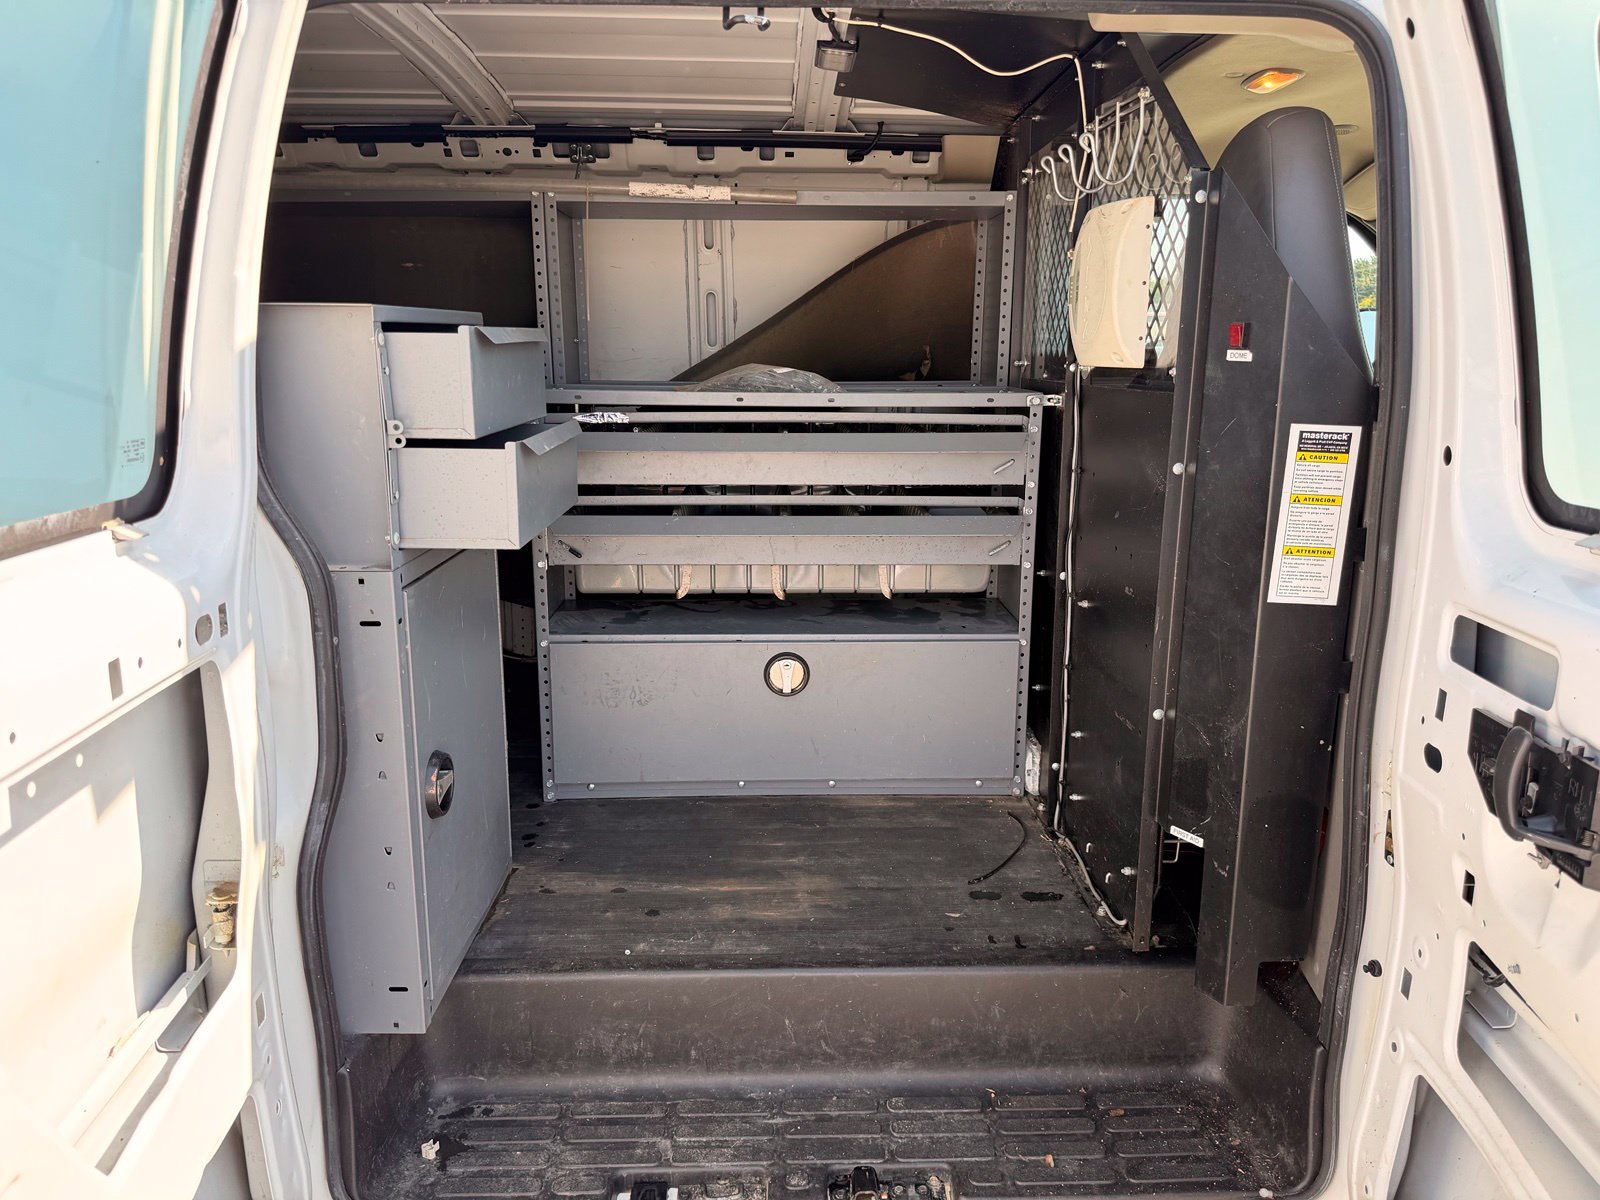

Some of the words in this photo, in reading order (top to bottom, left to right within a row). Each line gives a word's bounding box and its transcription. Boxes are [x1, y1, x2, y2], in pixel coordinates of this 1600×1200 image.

[1229, 351, 1248, 359] DOME
[1302, 432, 1348, 441] masterack
[1173, 827, 1189, 840] FIRST
[1190, 835, 1200, 844] AID
